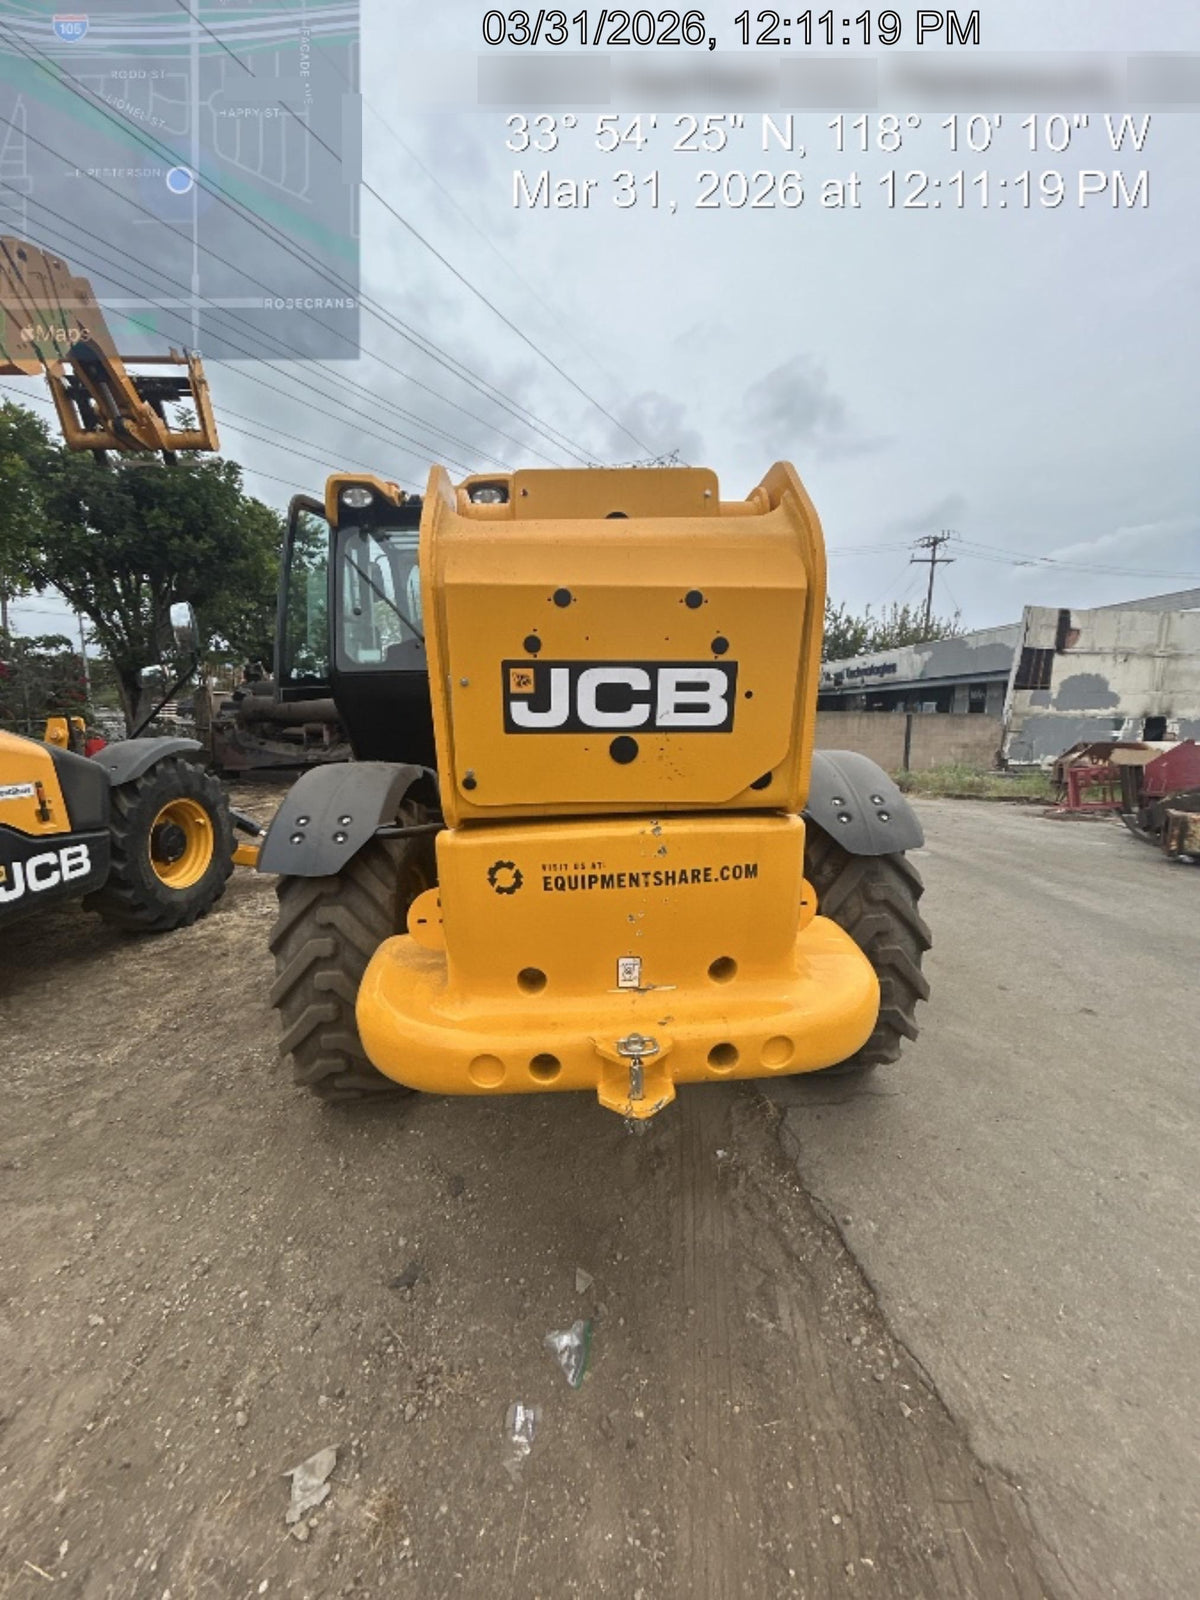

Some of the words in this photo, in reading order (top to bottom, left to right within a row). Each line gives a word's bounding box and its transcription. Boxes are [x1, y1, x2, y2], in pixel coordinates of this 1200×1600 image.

[509, 667, 729, 728] JCB
[0, 843, 91, 903] JCB
[542, 863, 759, 892] EQUIPMENTSHARE.COM
